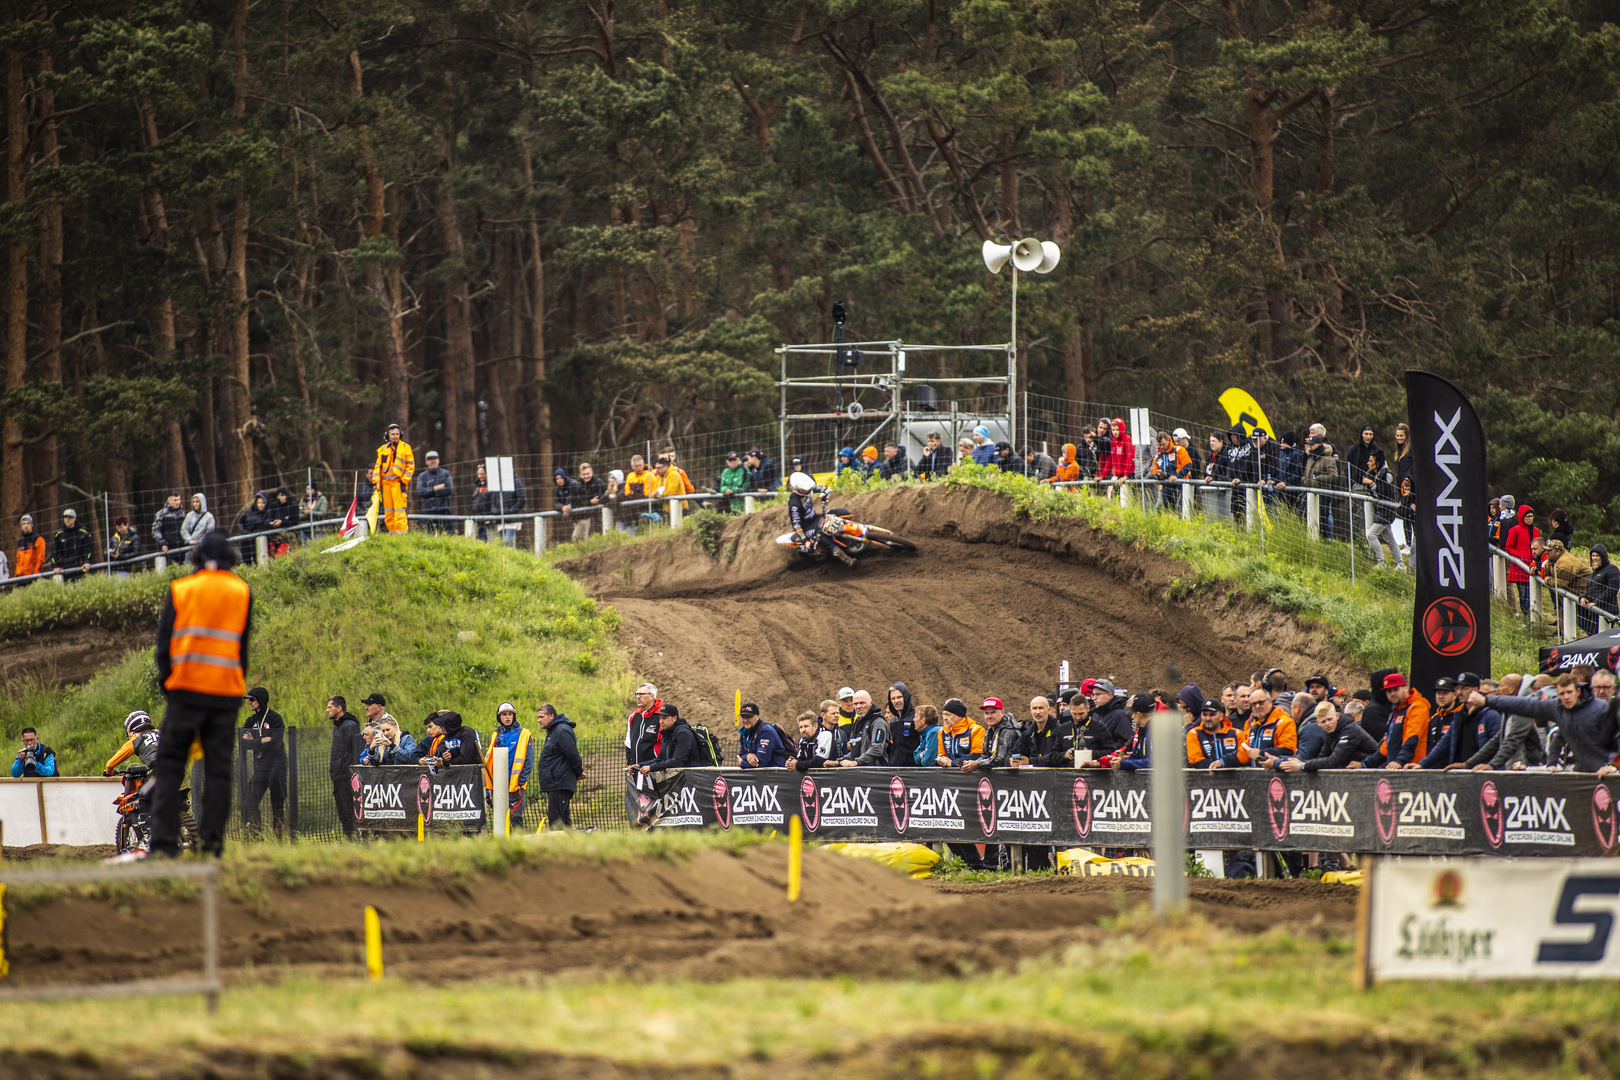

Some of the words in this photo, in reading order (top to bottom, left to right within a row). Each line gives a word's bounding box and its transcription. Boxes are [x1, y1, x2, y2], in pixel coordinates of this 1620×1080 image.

[1434, 406, 1466, 590] 24MX
[1559, 652, 1600, 669] 24MX
[364, 784, 404, 808] 24MX
[433, 784, 476, 809] 24MX
[732, 784, 782, 812] 24MX
[820, 786, 875, 814] 24MX
[909, 788, 962, 817] 24MX
[997, 790, 1050, 819] 24MX
[1092, 790, 1149, 819] 24MX
[1190, 788, 1249, 819] 24MX
[1290, 790, 1352, 822] 24MX
[1398, 792, 1462, 824] 24MX
[1504, 796, 1571, 831] 24MX
